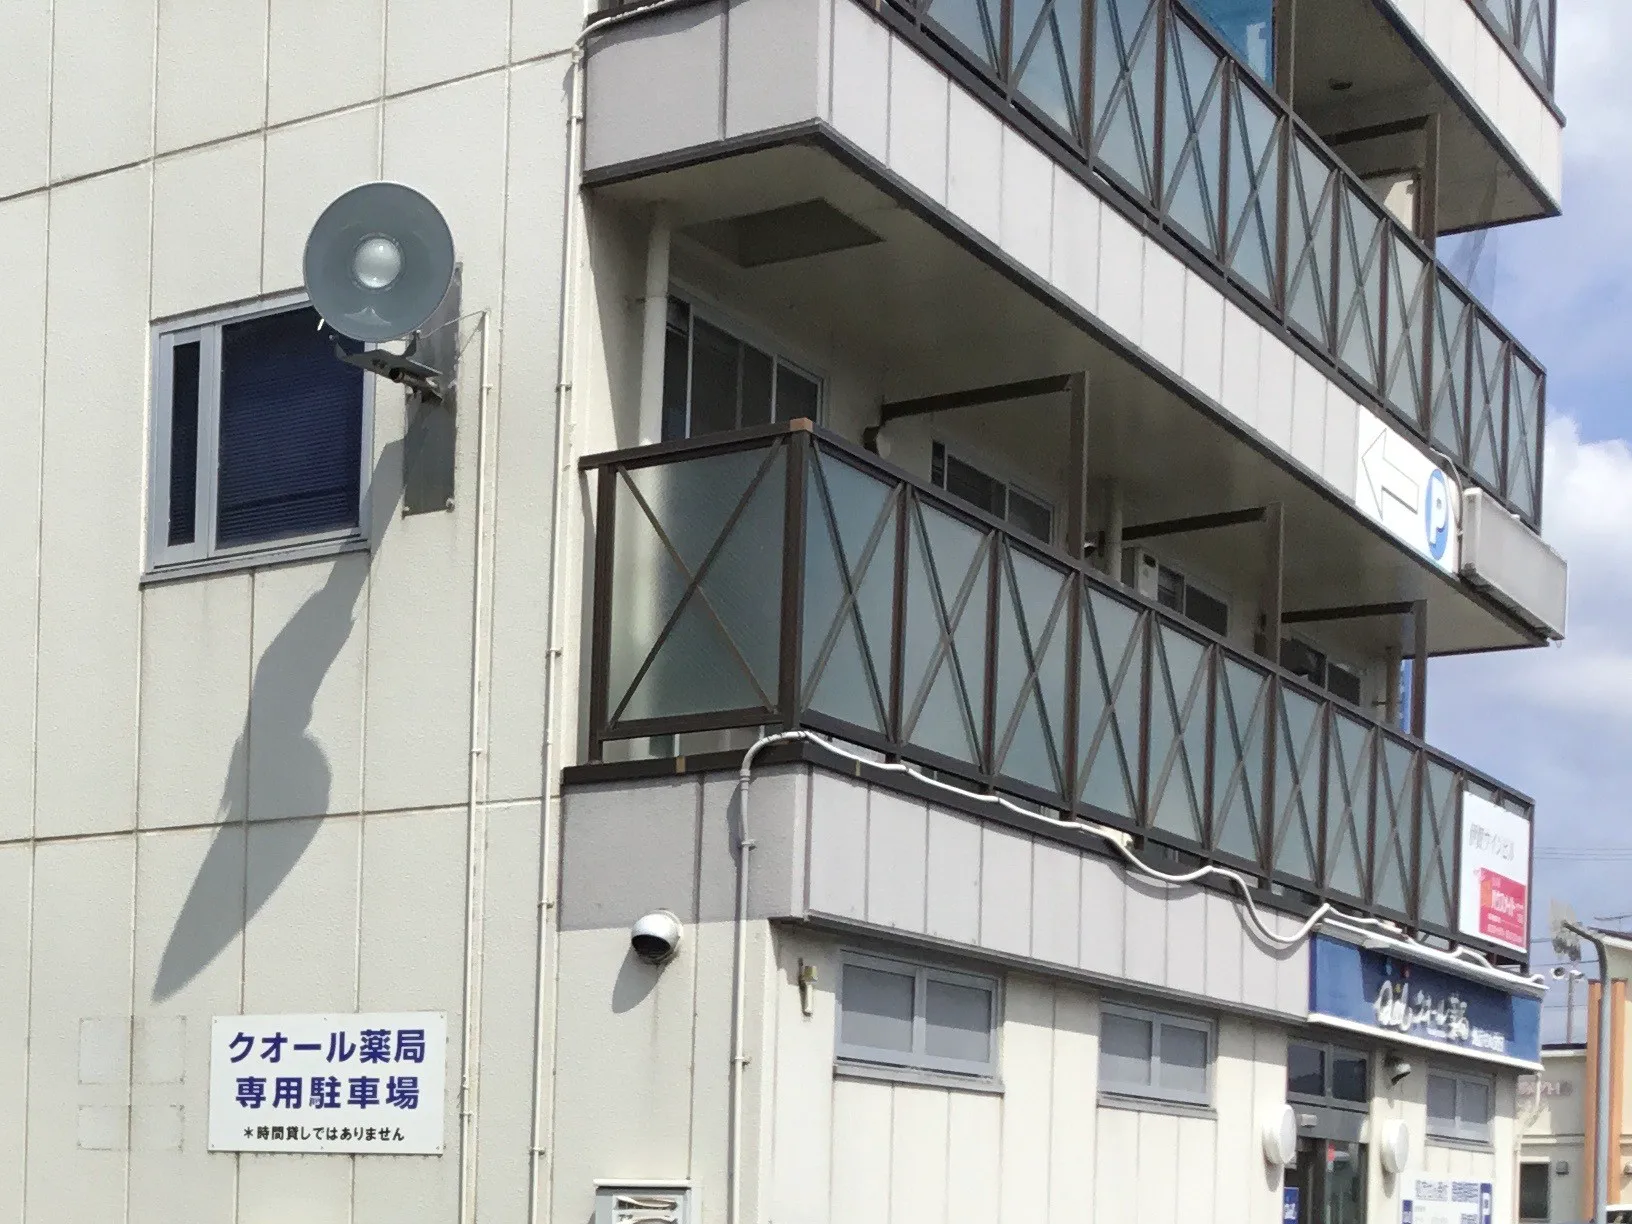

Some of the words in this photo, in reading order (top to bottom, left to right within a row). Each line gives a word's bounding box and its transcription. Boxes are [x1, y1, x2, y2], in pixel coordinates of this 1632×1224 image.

[228, 1028, 427, 1064] クオール薬局
[234, 1075, 421, 1110] 専用駐車場
